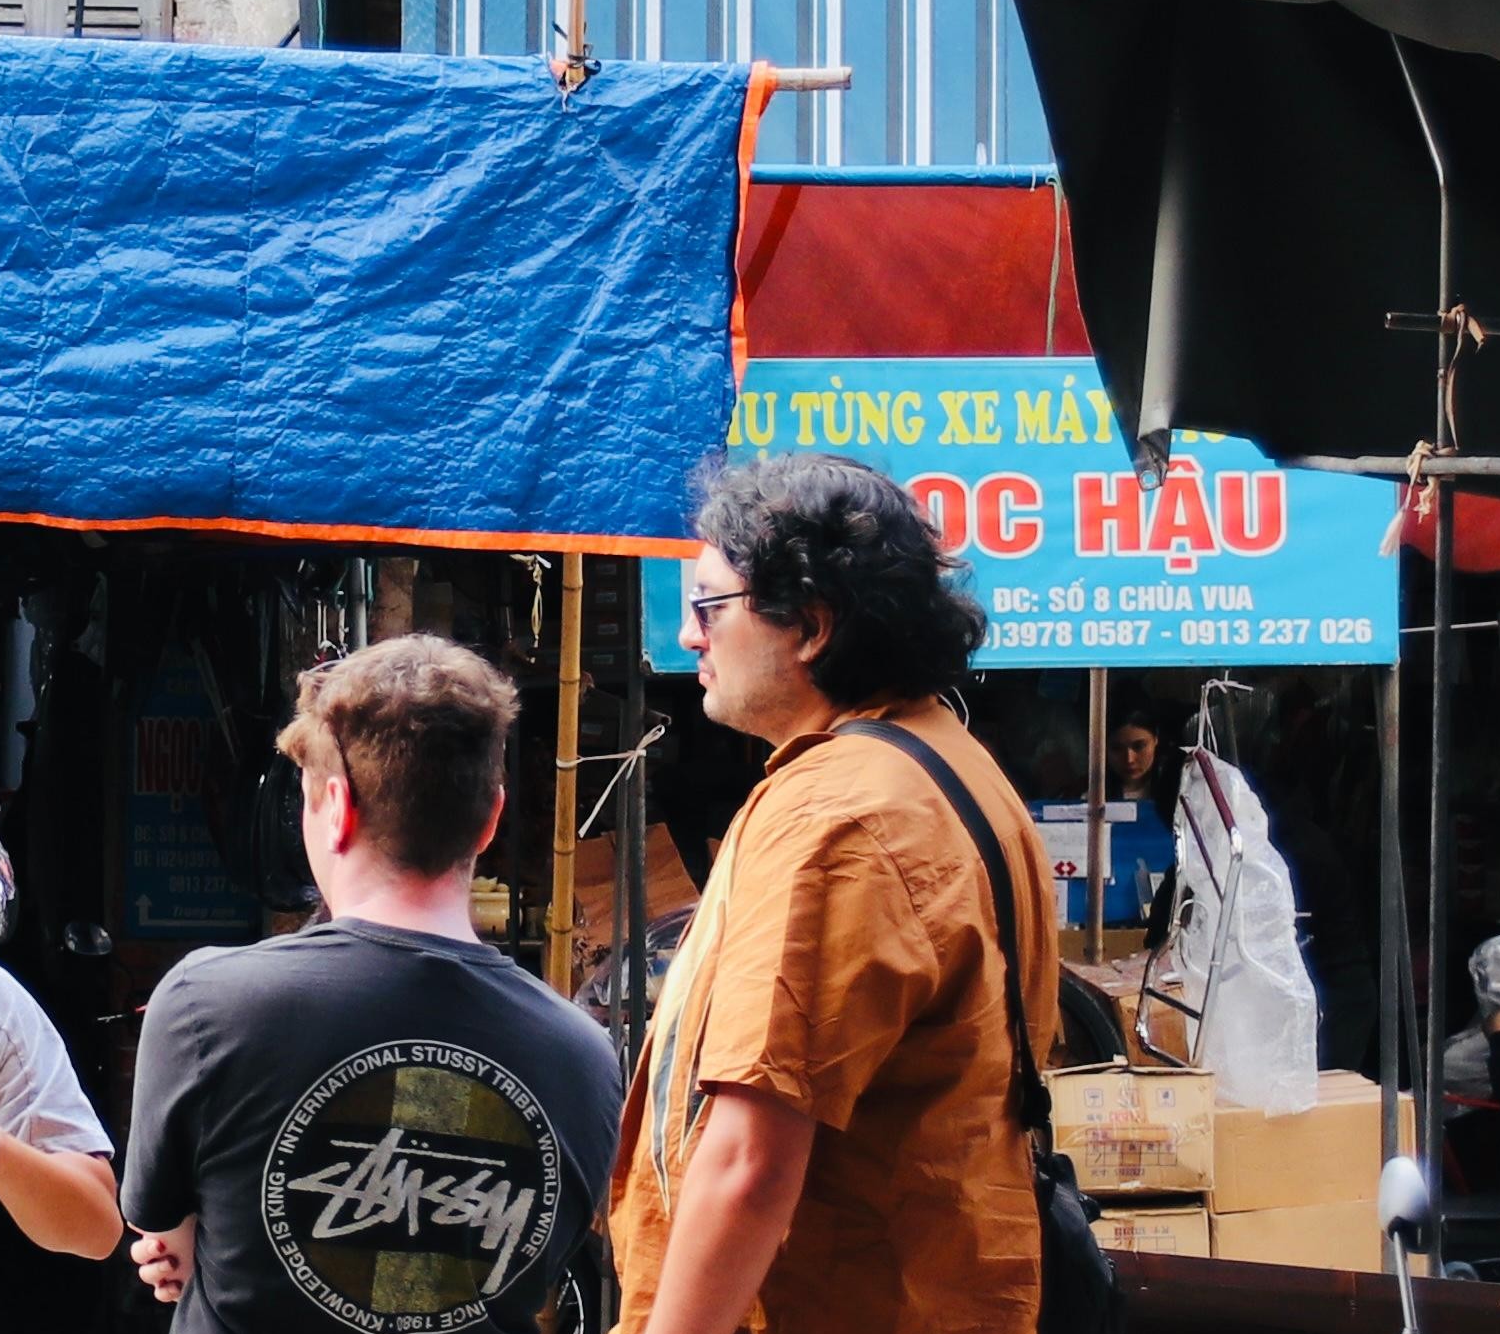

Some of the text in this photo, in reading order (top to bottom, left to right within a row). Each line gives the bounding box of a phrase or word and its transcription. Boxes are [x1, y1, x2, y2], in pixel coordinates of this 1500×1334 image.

[790, 375, 926, 446] TÙNG
[938, 390, 1001, 445] XE
[1014, 375, 1117, 445] MÁY
[1073, 453, 1287, 575] HẬU
[994, 578, 1254, 613] ĐC: SỐ 8 CHÙA VUA
[1081, 620, 1152, 647] 0587
[1180, 619, 1251, 647] 0913
[1258, 618, 1311, 646] 237
[1320, 617, 1373, 645] 026
[410, 1044, 490, 1077] STUSSY
[278, 1045, 407, 1155] INTERNATIONAL
[492, 1069, 538, 1123] TRIBE
[537, 1132, 557, 1205] WORLD
[267, 1171, 286, 1218] KING
[272, 1221, 292, 1240] IS
[523, 1211, 558, 1259] WIDE
[281, 1240, 385, 1333] KNOWLEDGE
[440, 1298, 487, 1329] INCE
